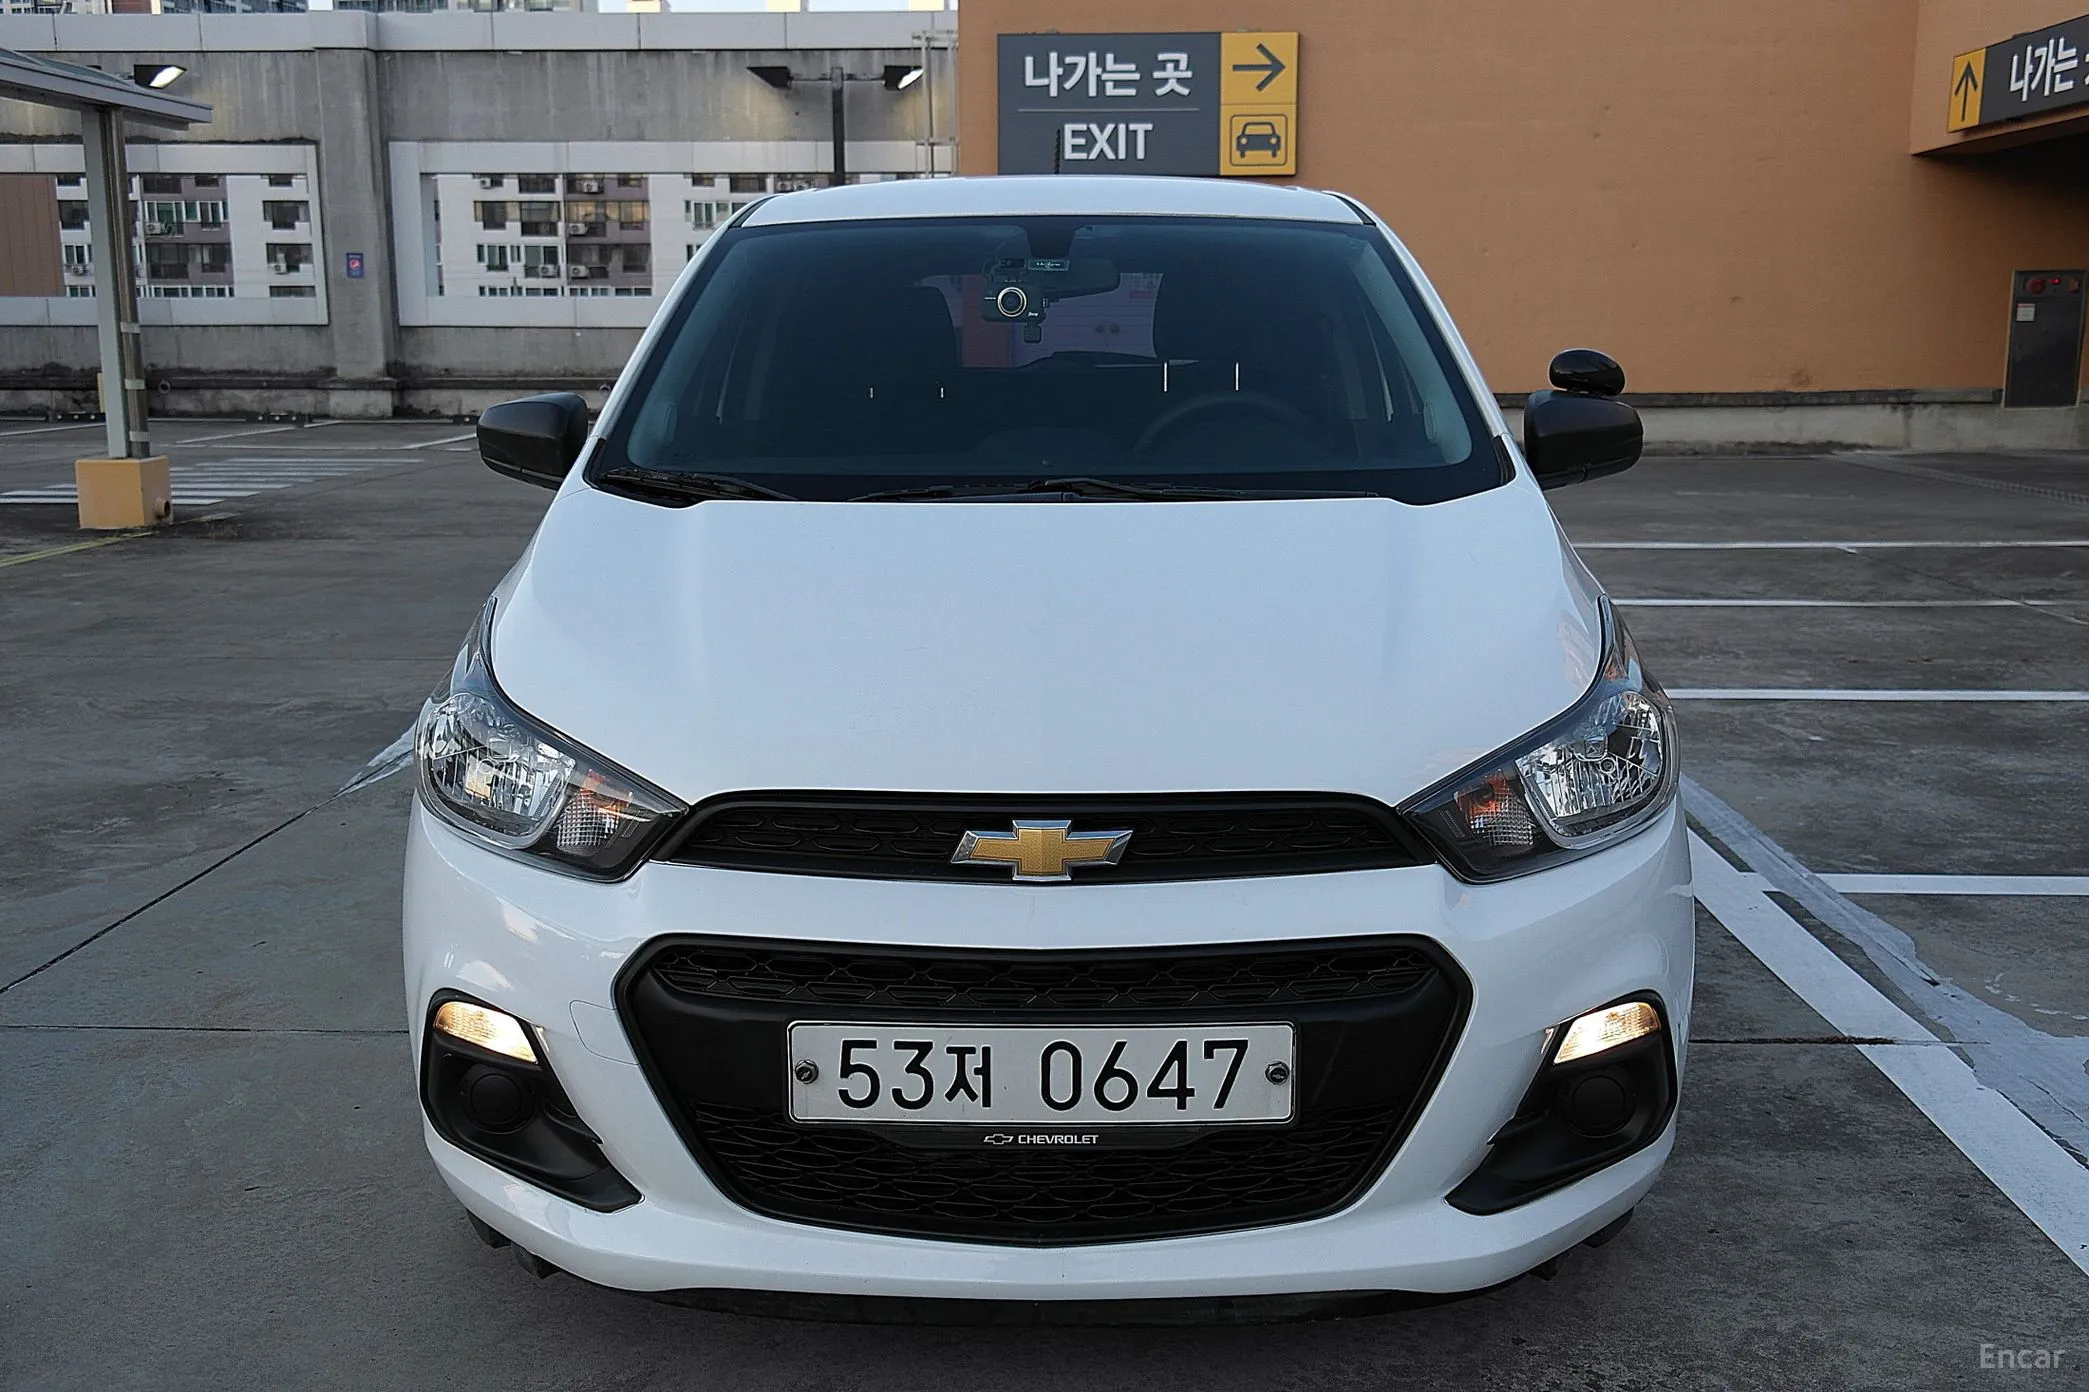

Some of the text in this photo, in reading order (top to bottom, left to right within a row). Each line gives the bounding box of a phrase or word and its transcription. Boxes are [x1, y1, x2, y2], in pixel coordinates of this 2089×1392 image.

[1023, 51, 1193, 97] 나가는 곳
[2009, 36, 2078, 102] 나가는
[1063, 123, 1153, 160] EXIT
[837, 1039, 1249, 1112] 53저 0647
[1018, 1134, 1099, 1144] CHEVROLET
